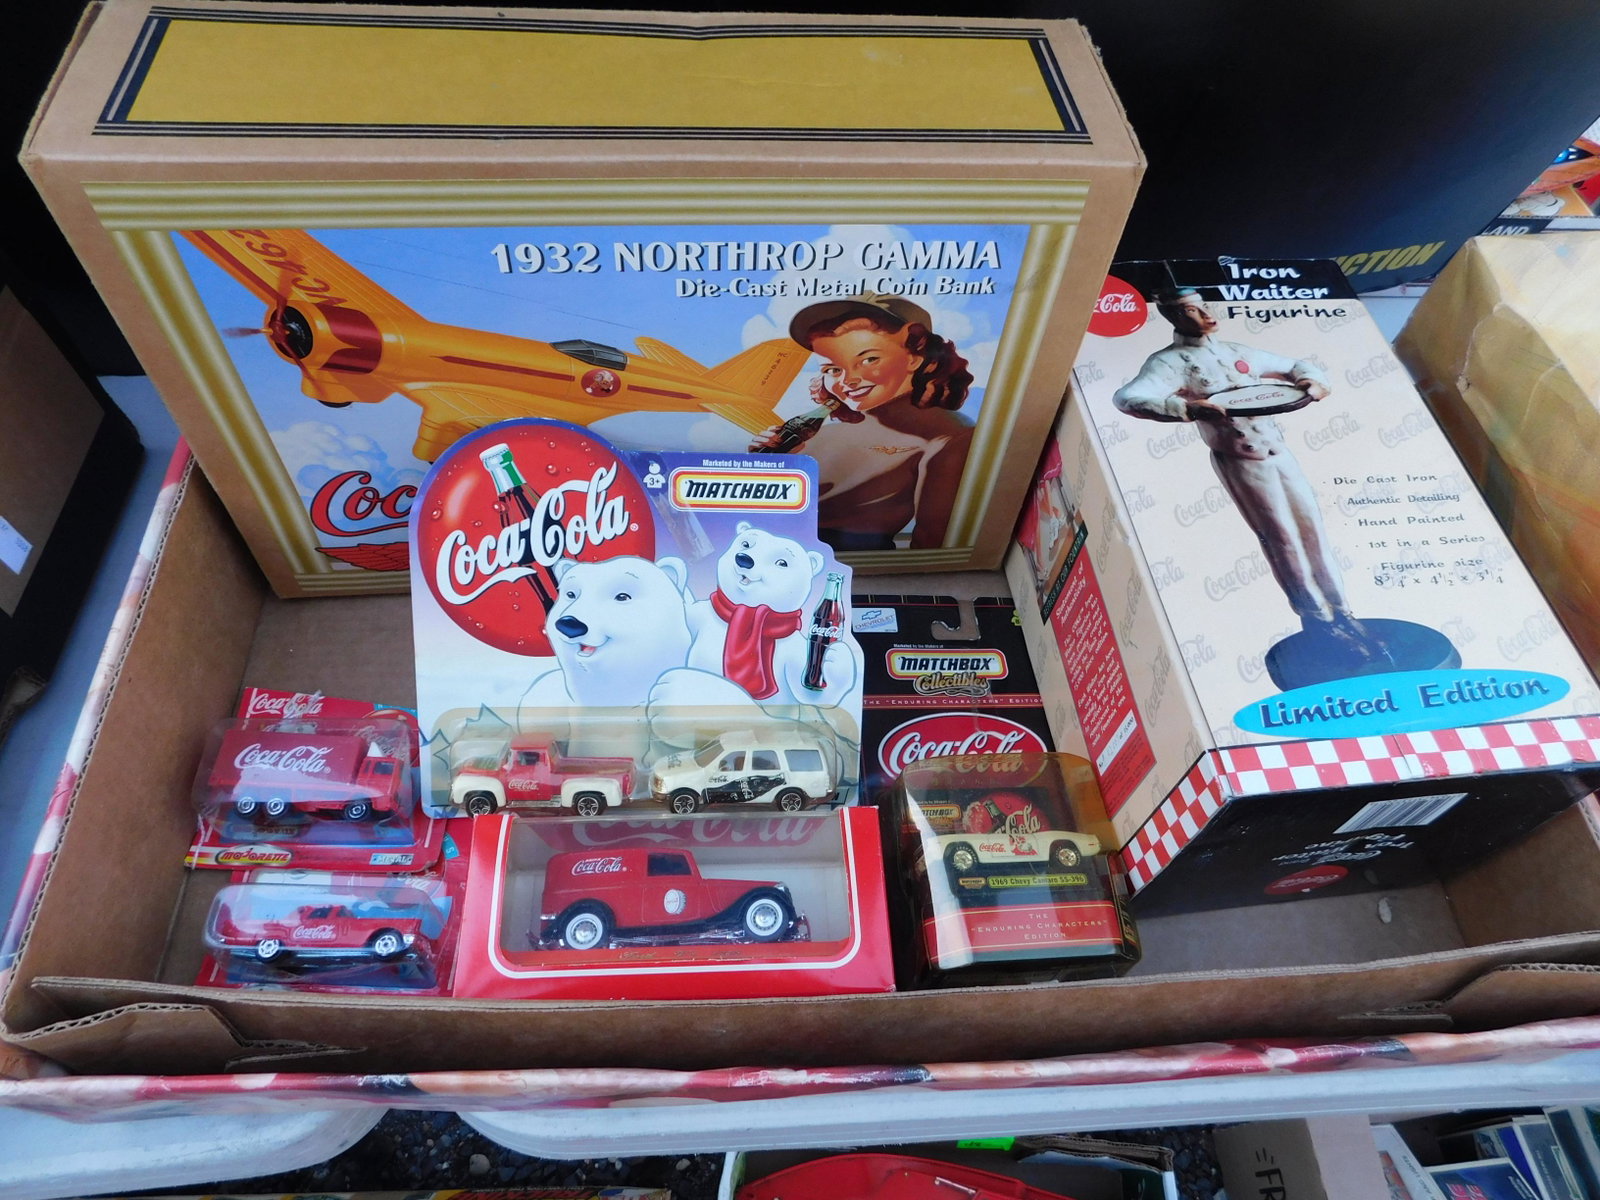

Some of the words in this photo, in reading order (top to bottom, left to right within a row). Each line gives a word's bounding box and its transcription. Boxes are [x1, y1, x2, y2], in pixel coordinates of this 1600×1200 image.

[490, 242, 601, 274] 1932
[614, 241, 843, 273] NORTHROP
[861, 241, 1001, 270] GAMMA
[1227, 263, 1301, 280] Iron
[676, 277, 788, 299] Die-Cast
[797, 276, 866, 297] Metal
[876, 276, 928, 296] Coin
[936, 276, 996, 295] Bank
[1218, 285, 1328, 300] Waiter
[1227, 306, 1347, 323] Figurine
[1146, 424, 1201, 459] Coca-Col
[702, 459, 732, 468] Marketed
[733, 460, 741, 469] by
[742, 460, 753, 468] the
[753, 460, 775, 468] Makers
[776, 460, 785, 469] of
[1334, 477, 1357, 485] Die
[1367, 476, 1397, 484] Cast
[1407, 474, 1438, 482] Iron
[685, 480, 796, 500] MATCHBOX
[1347, 497, 1401, 506] Authentic
[1407, 494, 1460, 503] Detailing
[1358, 518, 1398, 527] Hand
[1407, 513, 1465, 525] Painted
[436, 460, 631, 605] Coca-Cola
[1397, 539, 1412, 547] in
[1381, 561, 1445, 573] Figurine
[1455, 558, 1484, 567] size
[899, 656, 995, 670] MATCHBOX
[1260, 690, 1399, 730] Limited
[1418, 673, 1550, 710] Edition
[234, 743, 334, 774] Coca-Cola
[572, 857, 624, 876] Coca-Cola
[991, 877, 1008, 886] 1969
[1010, 877, 1031, 886] Chevy
[1032, 876, 1058, 885] Camaro
